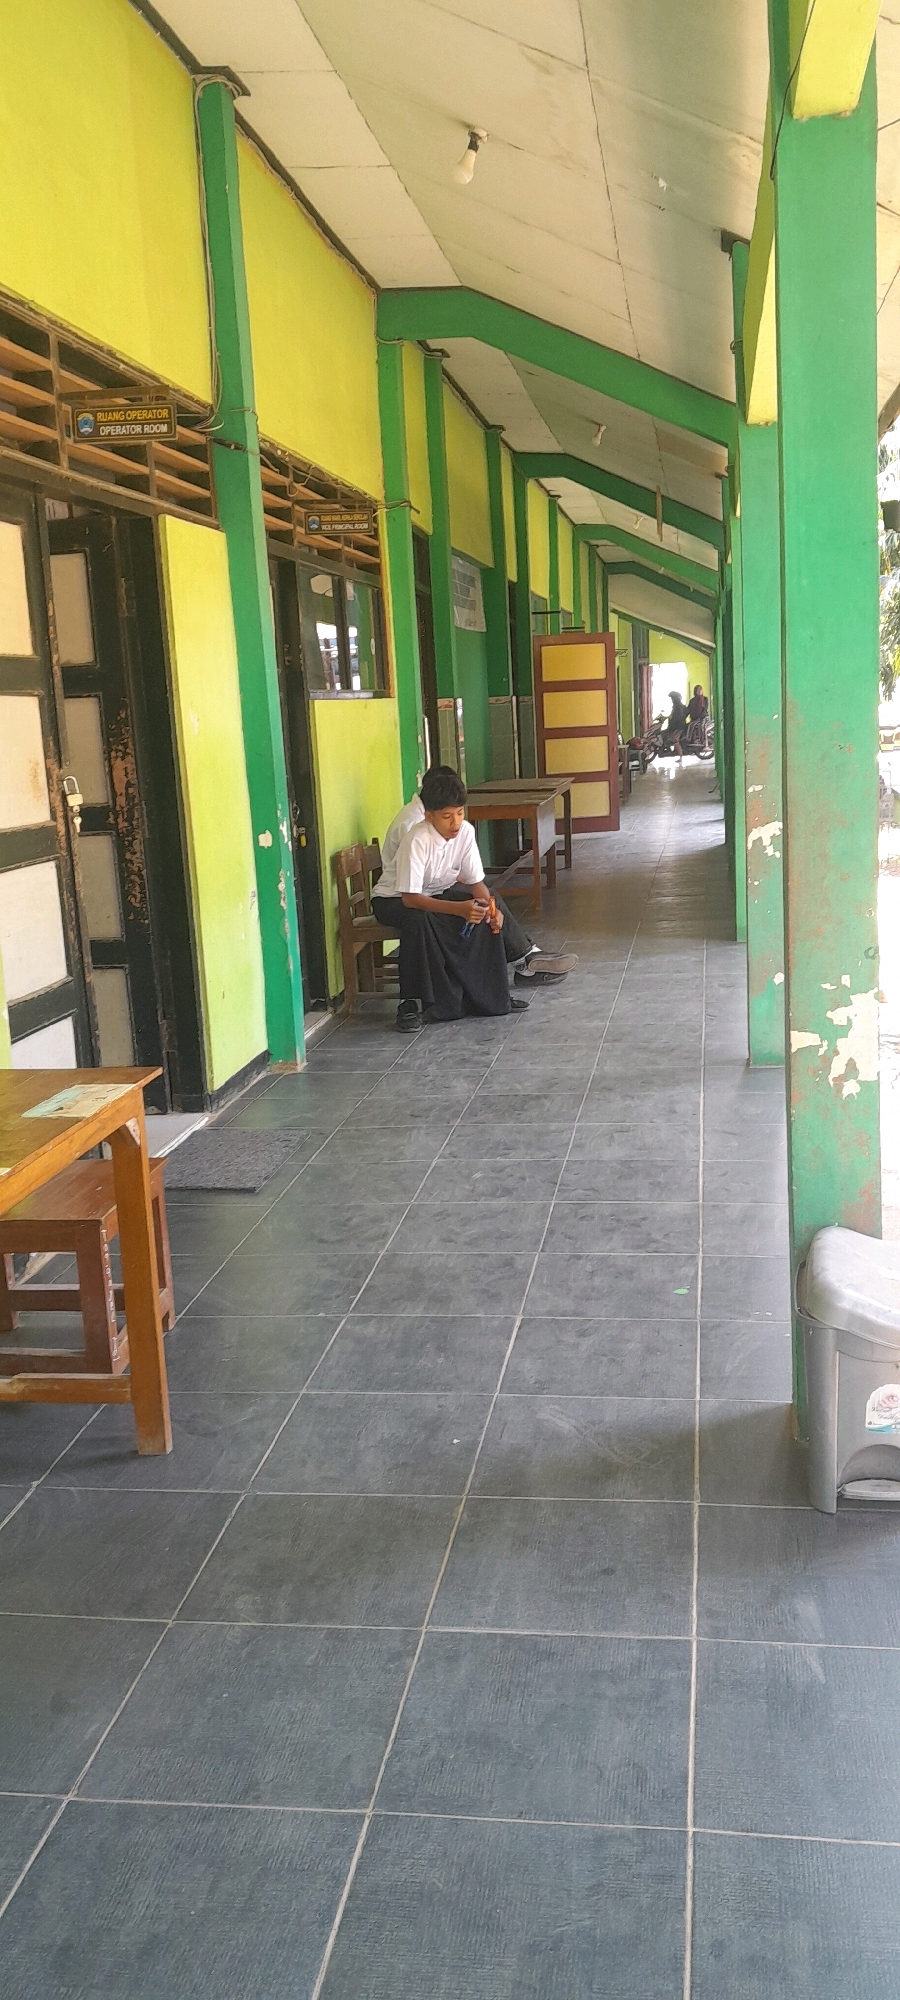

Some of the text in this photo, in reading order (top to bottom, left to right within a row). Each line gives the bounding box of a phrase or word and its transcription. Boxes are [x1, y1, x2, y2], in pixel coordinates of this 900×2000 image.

[96, 409, 169, 422] RUANG OPERATOR
[99, 423, 168, 436] OPERATOR ROOM
